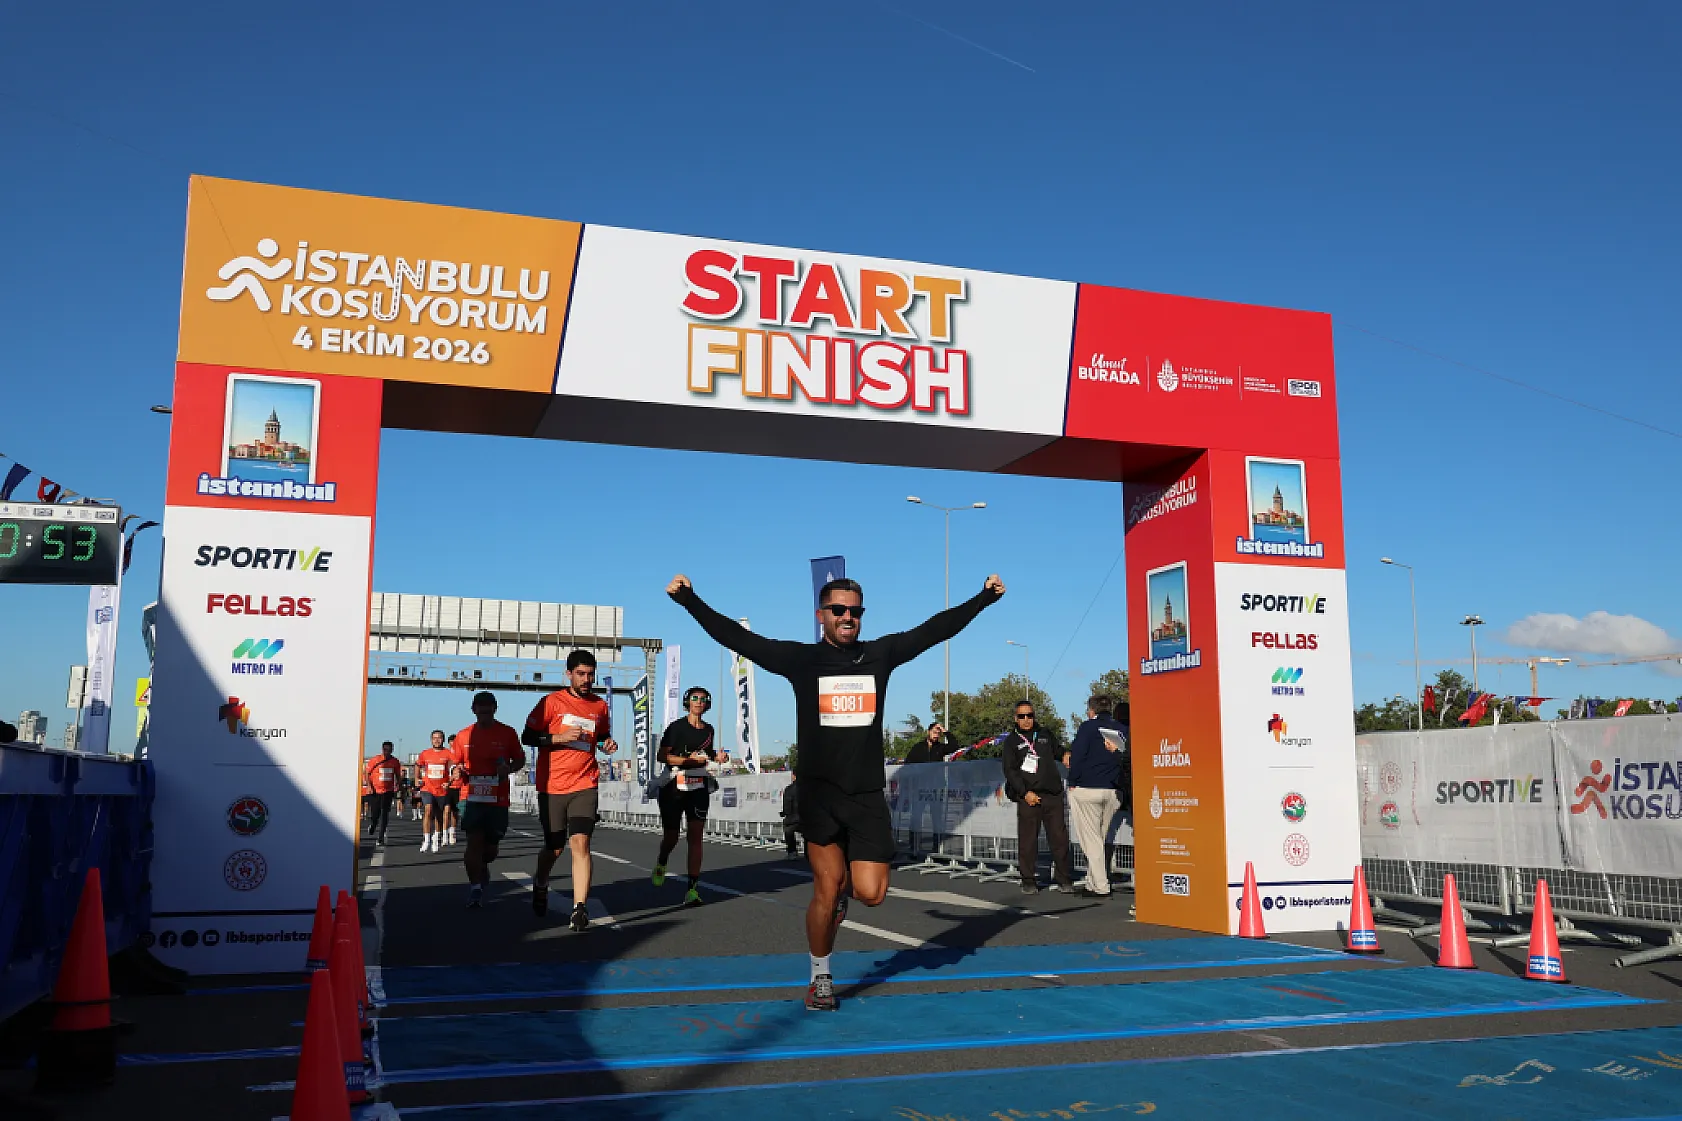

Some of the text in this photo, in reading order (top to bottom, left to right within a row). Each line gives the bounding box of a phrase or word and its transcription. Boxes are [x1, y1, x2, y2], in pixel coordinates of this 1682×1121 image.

[294, 241, 550, 300] İSTANBULU
[681, 249, 964, 339] START
[292, 325, 490, 364] 4 EKİM 2026
[687, 323, 969, 415] FINISH
[1078, 366, 1140, 385] BURADA
[197, 472, 336, 502] istanbul
[194, 545, 333, 572] SPORTIVE
[1236, 536, 1324, 559] istanbul
[1240, 593, 1327, 614] SPORTIVE
[231, 662, 284, 675] METRO FM
[1141, 649, 1201, 676] istanbul
[831, 695, 864, 712] 9081
[1152, 753, 1191, 768] BURADA
[1435, 773, 1544, 804] SPORTIVE
